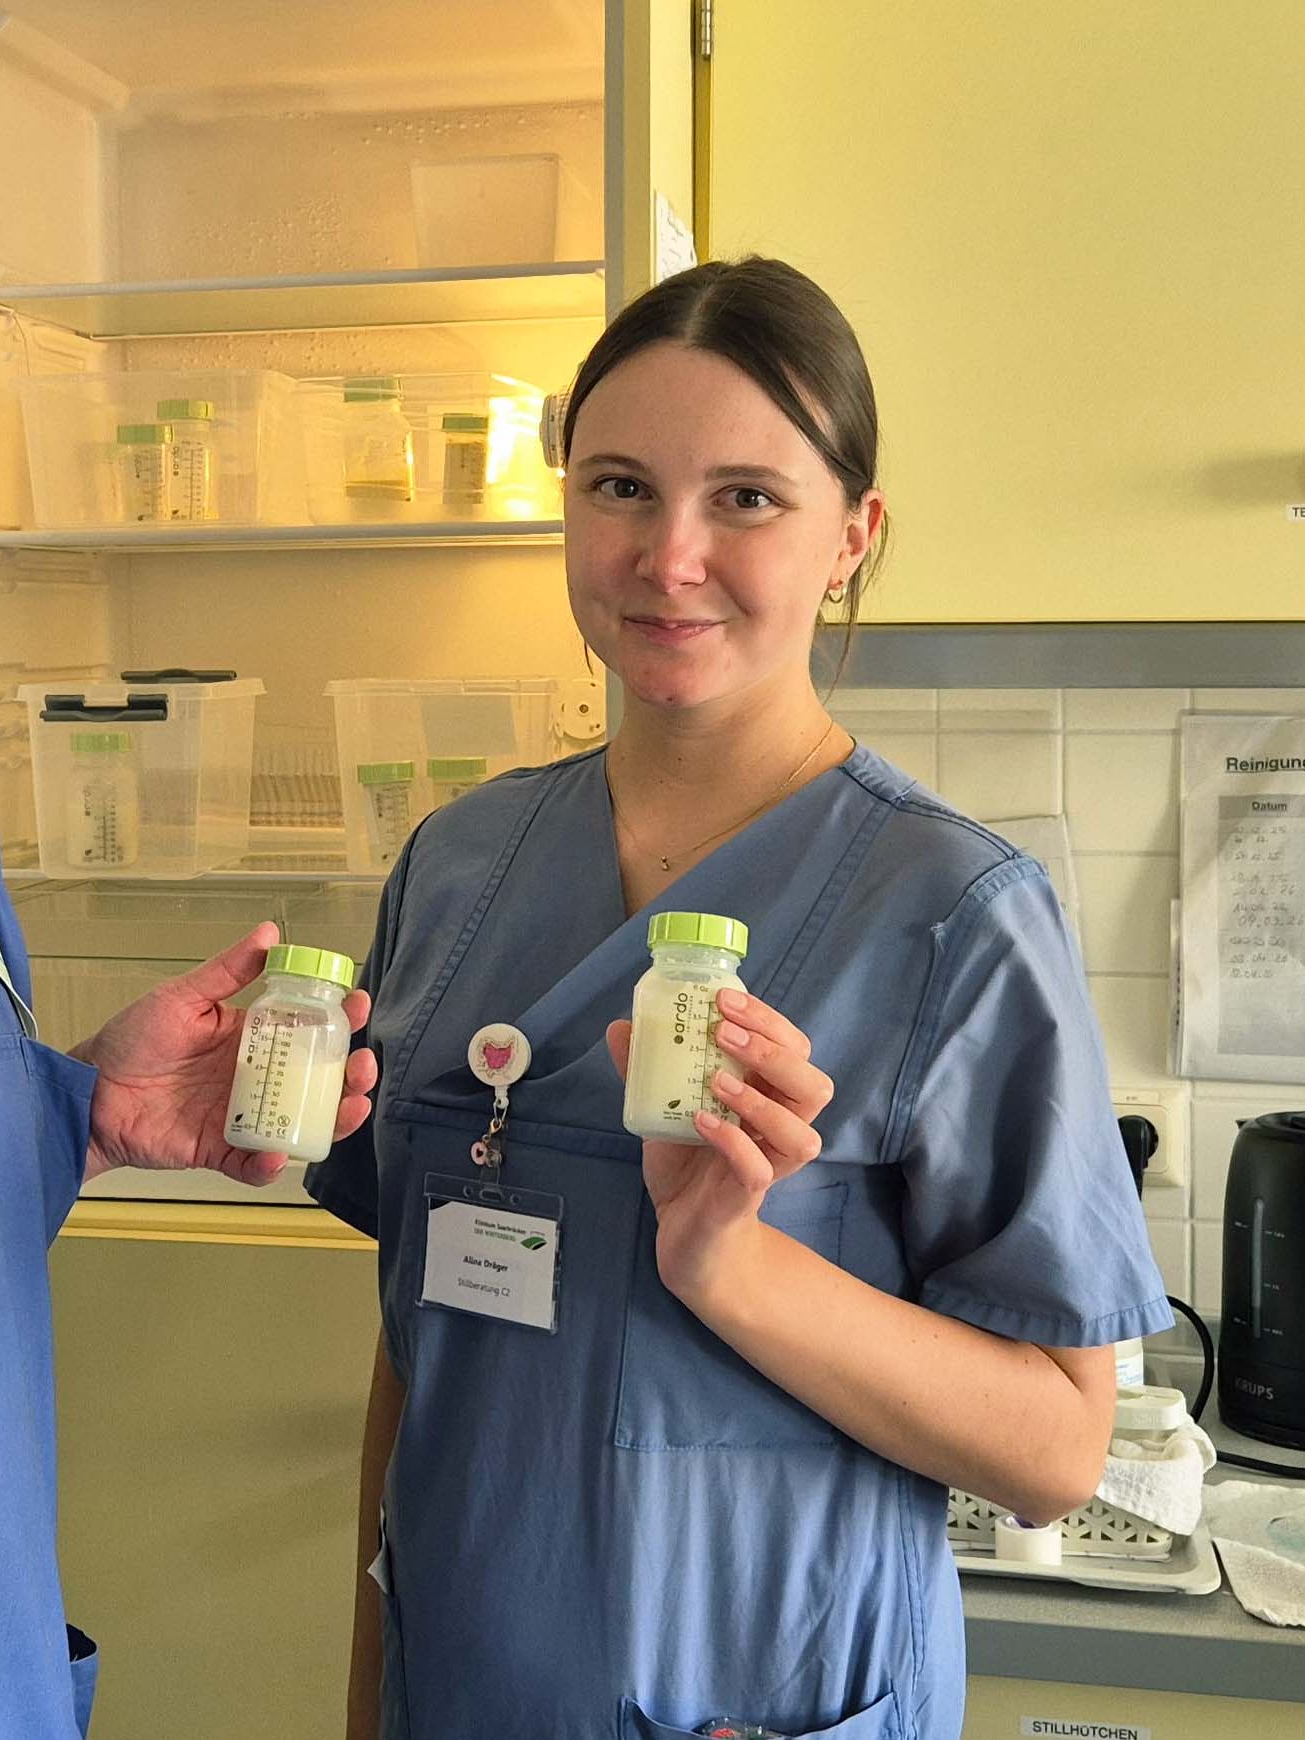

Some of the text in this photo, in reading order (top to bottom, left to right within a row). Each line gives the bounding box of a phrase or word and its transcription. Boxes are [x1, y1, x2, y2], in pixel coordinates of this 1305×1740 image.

[1226, 757, 1305, 772] Reinigun
[1252, 801, 1287, 811] Datum
[674, 993, 688, 1033] ardo
[248, 1017, 260, 1053] ardo
[463, 1256, 508, 1272] Alina Dräger
[457, 1278, 511, 1297] Stillberatung C2
[1235, 1378, 1274, 1400] KRUPS
